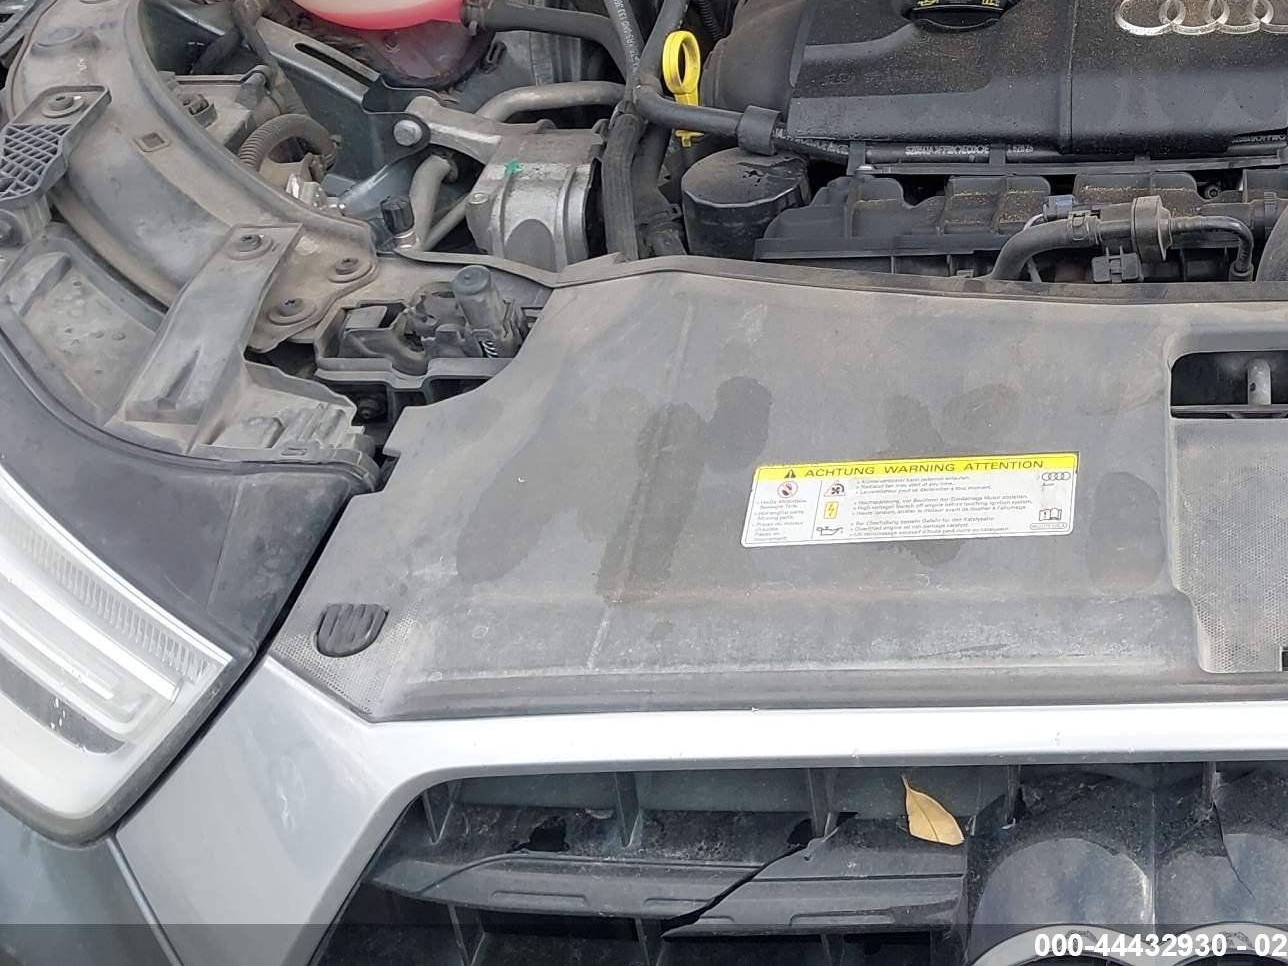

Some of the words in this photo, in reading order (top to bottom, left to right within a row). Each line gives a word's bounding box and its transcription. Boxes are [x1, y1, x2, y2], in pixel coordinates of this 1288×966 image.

[804, 466, 875, 478] ACHTUNG
[884, 463, 955, 474] WARNING
[963, 460, 1044, 472] ATTENTION
